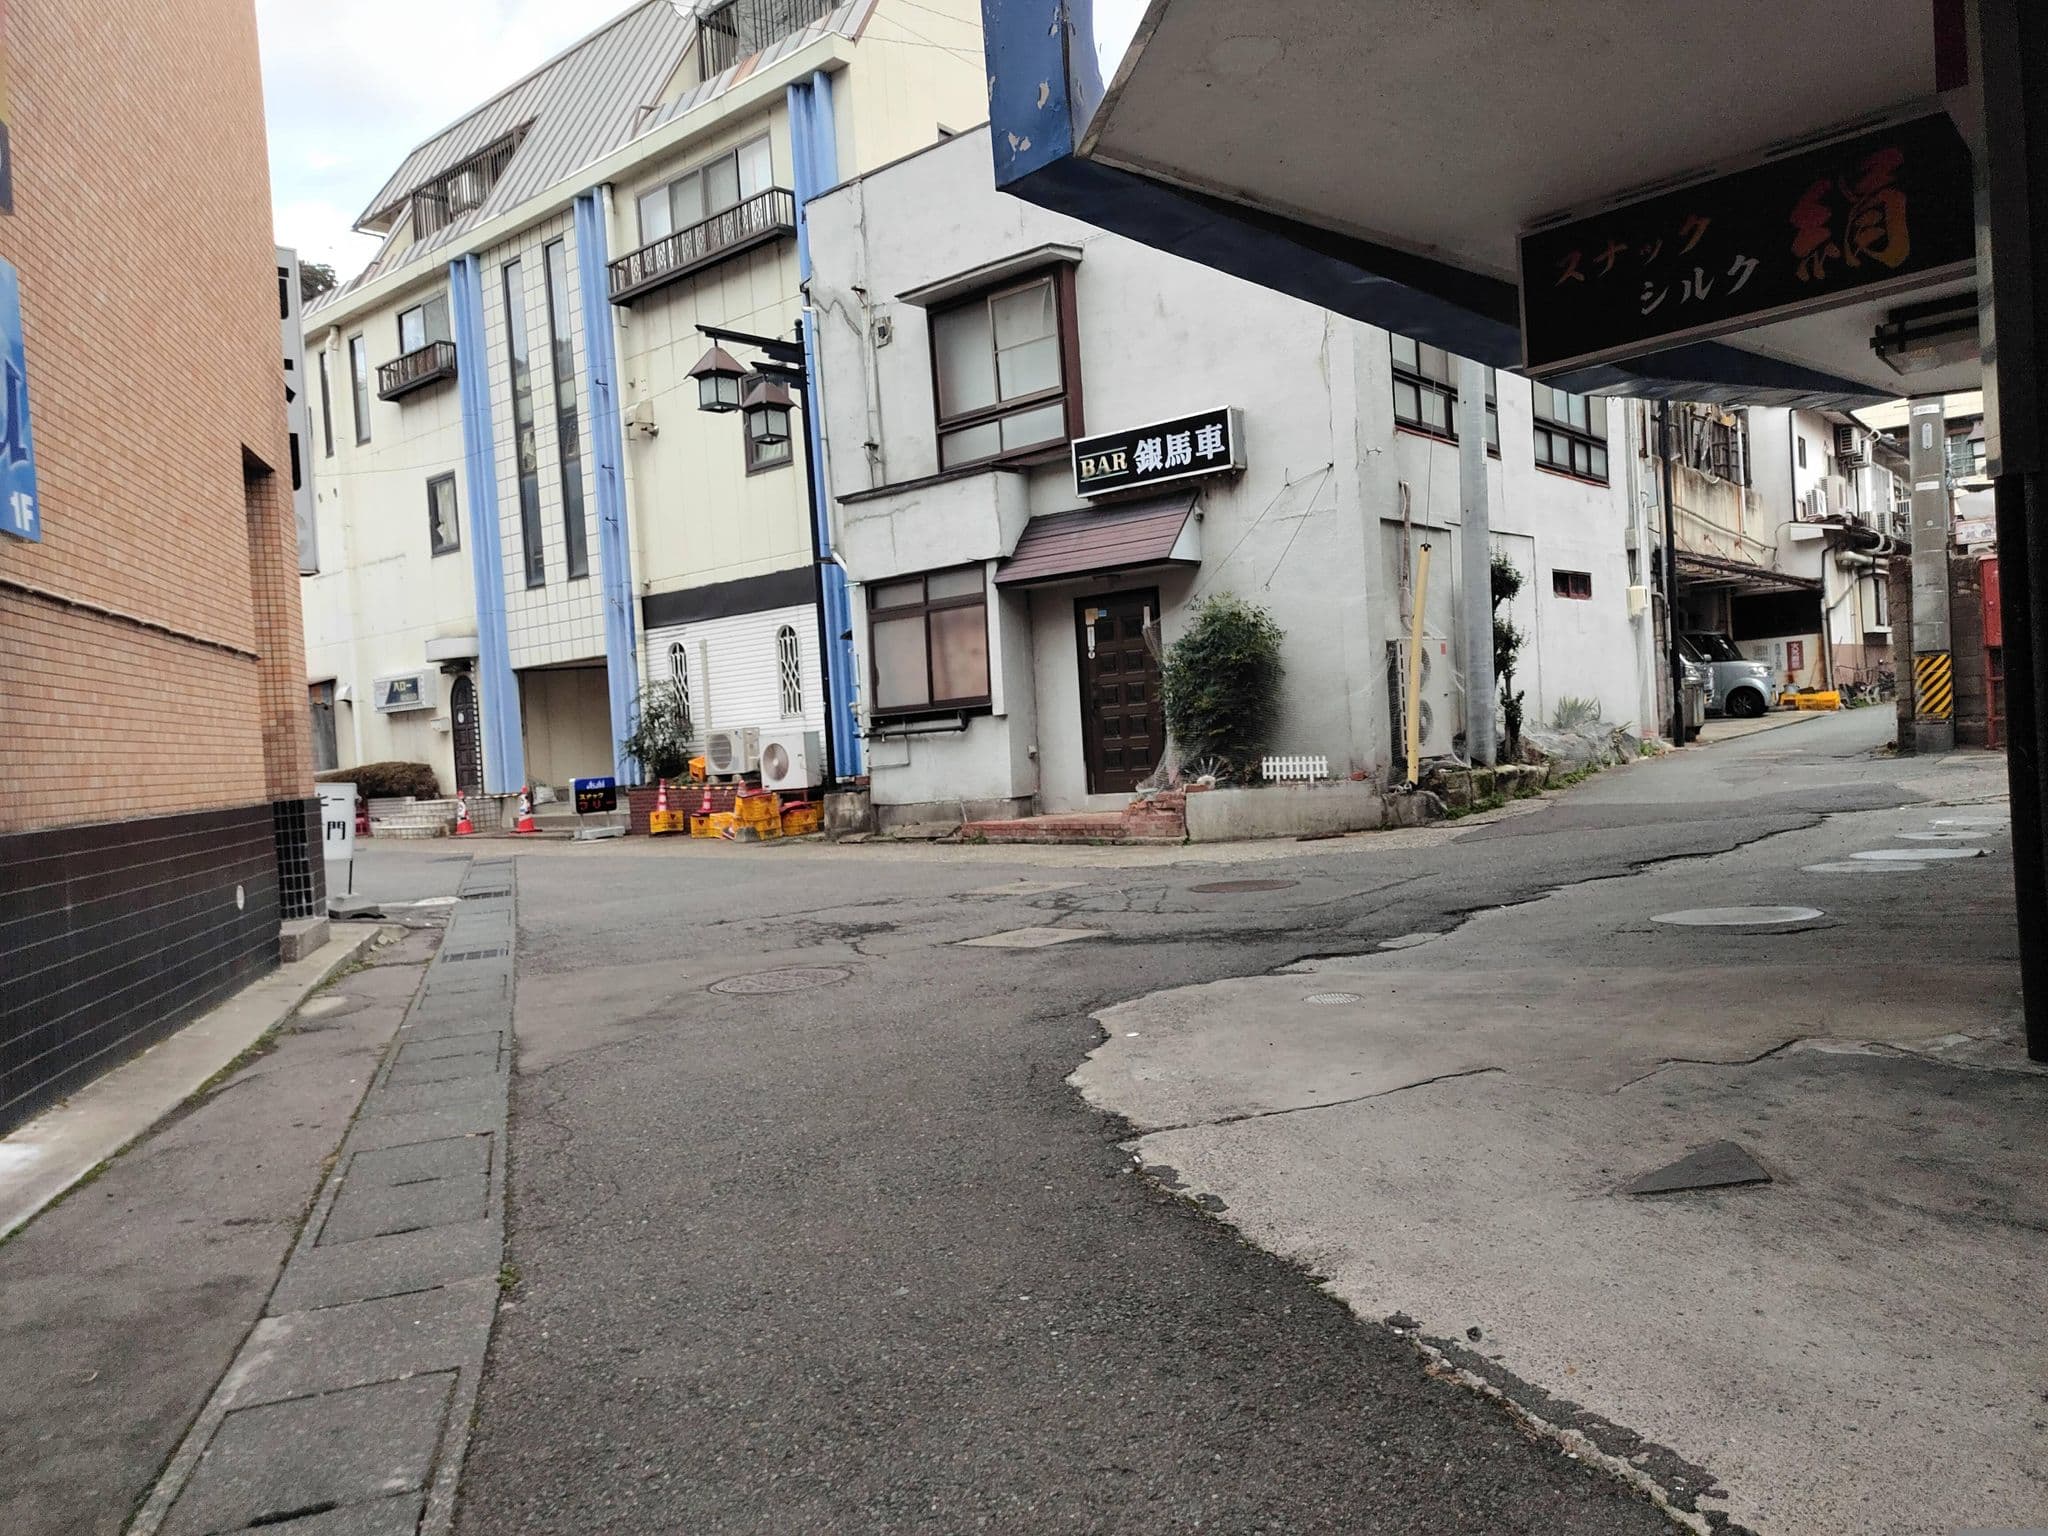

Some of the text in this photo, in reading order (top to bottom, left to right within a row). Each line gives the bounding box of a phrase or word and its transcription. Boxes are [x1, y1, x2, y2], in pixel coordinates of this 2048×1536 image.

[1554, 213, 1712, 287] スナック
[1640, 253, 1760, 315] シルク
[1080, 452, 1128, 478] BAR
[1133, 423, 1226, 475] 銀馬車
[10, 491, 34, 532] 1F
